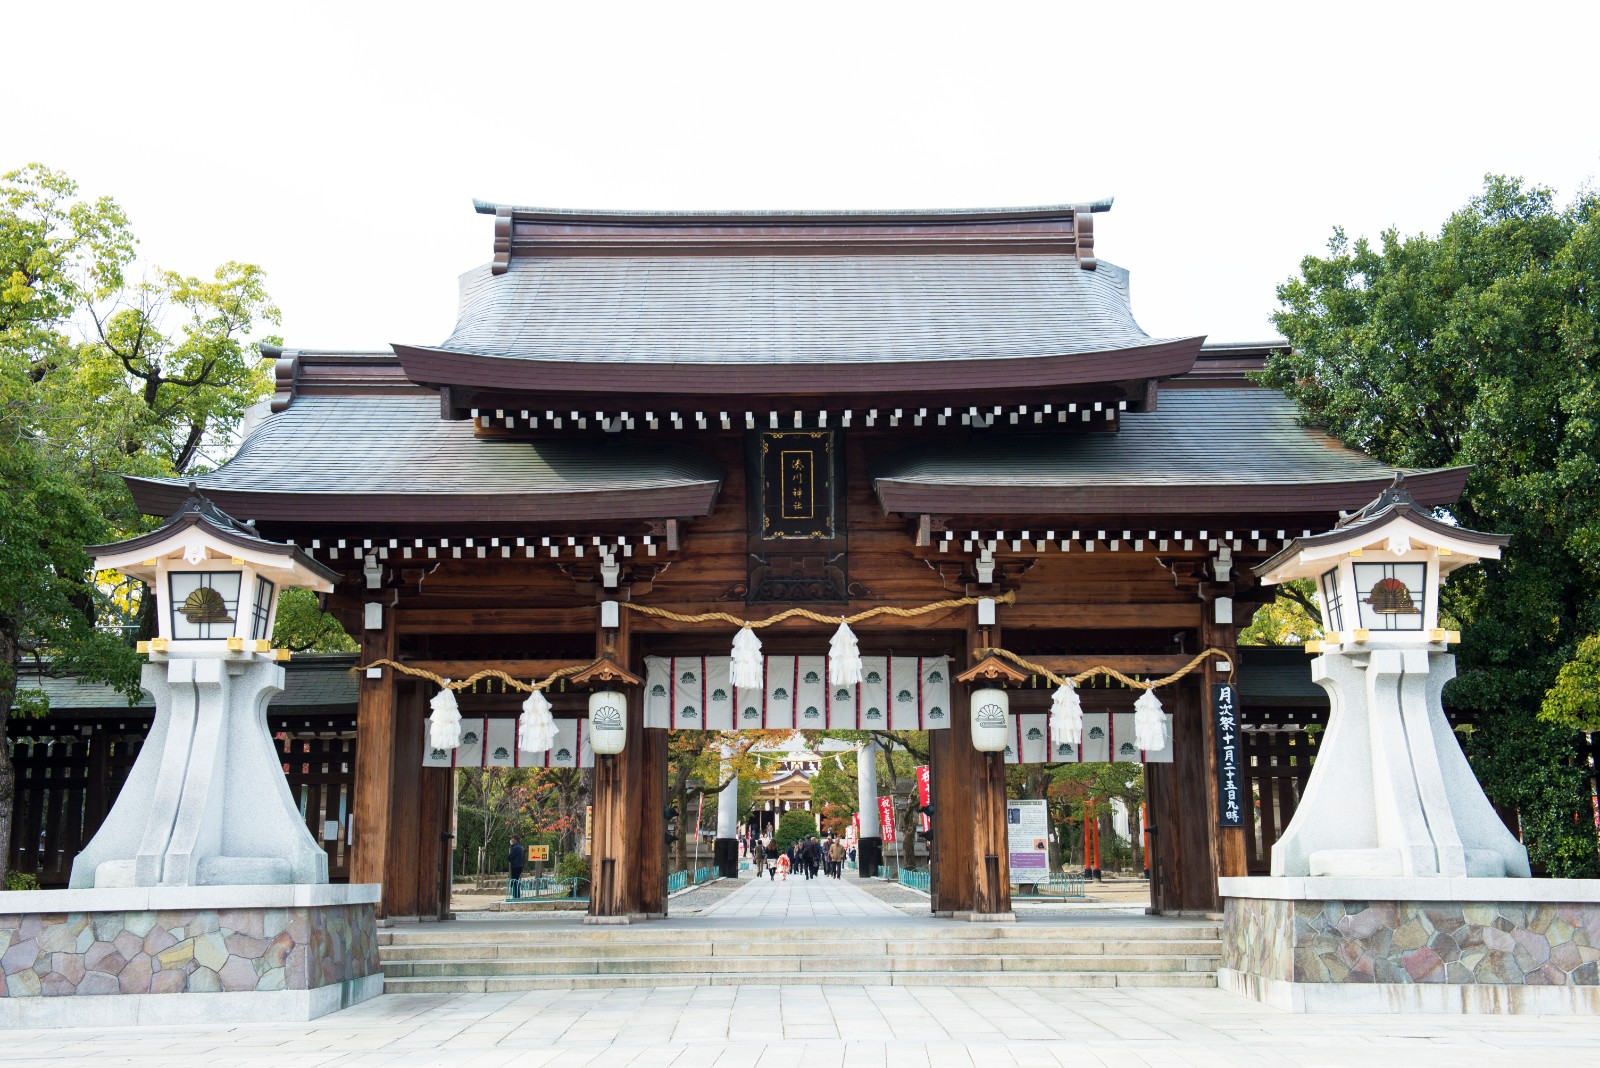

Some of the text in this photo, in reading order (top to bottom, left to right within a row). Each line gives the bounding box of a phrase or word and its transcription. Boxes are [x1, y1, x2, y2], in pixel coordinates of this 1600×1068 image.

[791, 458, 805, 511] 湊川神社
[1218, 686, 1240, 822] 月次祭十一月二十五日九時
